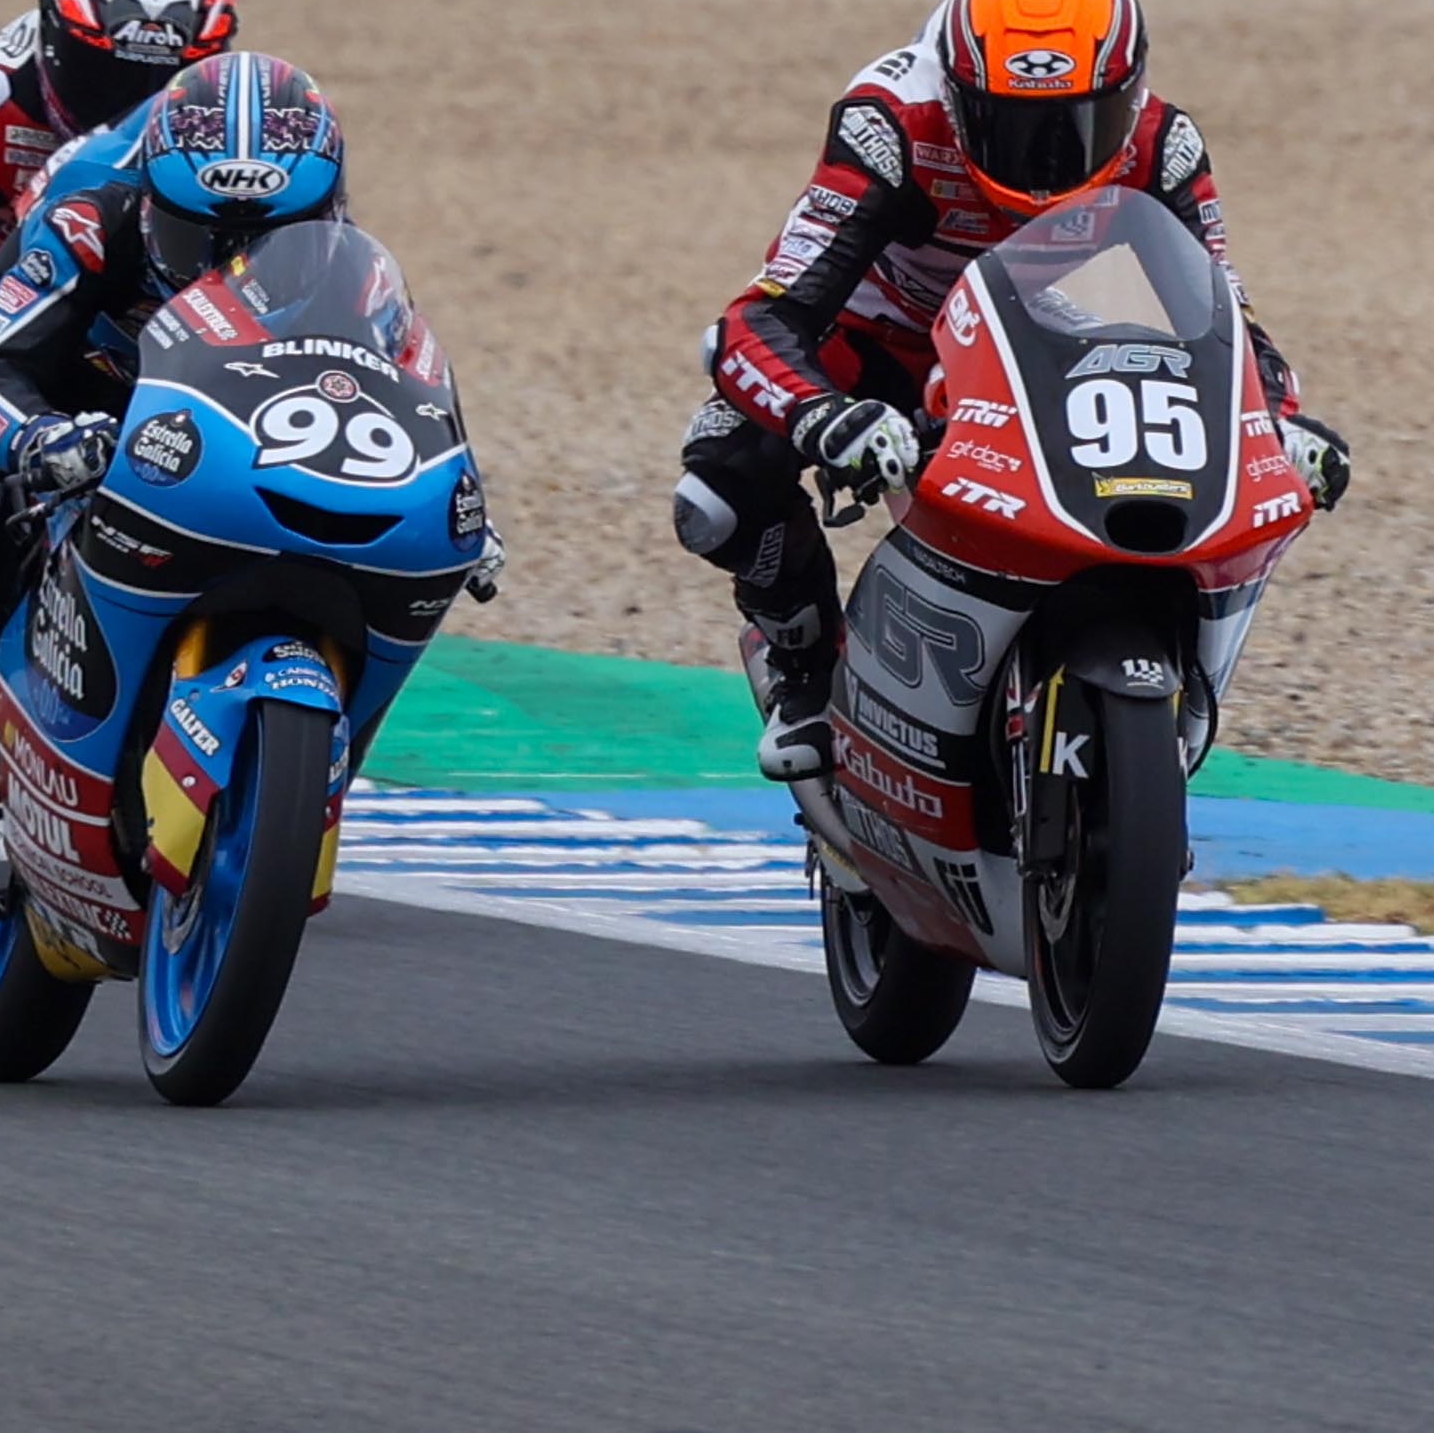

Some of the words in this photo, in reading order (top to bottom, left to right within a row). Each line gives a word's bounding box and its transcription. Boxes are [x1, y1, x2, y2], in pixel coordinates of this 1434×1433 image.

[113, 20, 183, 46] Airoh
[208, 168, 280, 190] NHK
[262, 338, 400, 383] BLINKER
[1064, 344, 1193, 379] AGR
[141, 419, 193, 455] Estrella
[258, 396, 415, 479] 99
[1066, 378, 1208, 471] 95
[133, 436, 181, 473] Galicia
[170, 698, 220, 756] GALFER
[14, 729, 79, 808] MONLAU
[832, 726, 943, 819] Kabuto
[7, 772, 81, 865] MOTUL
